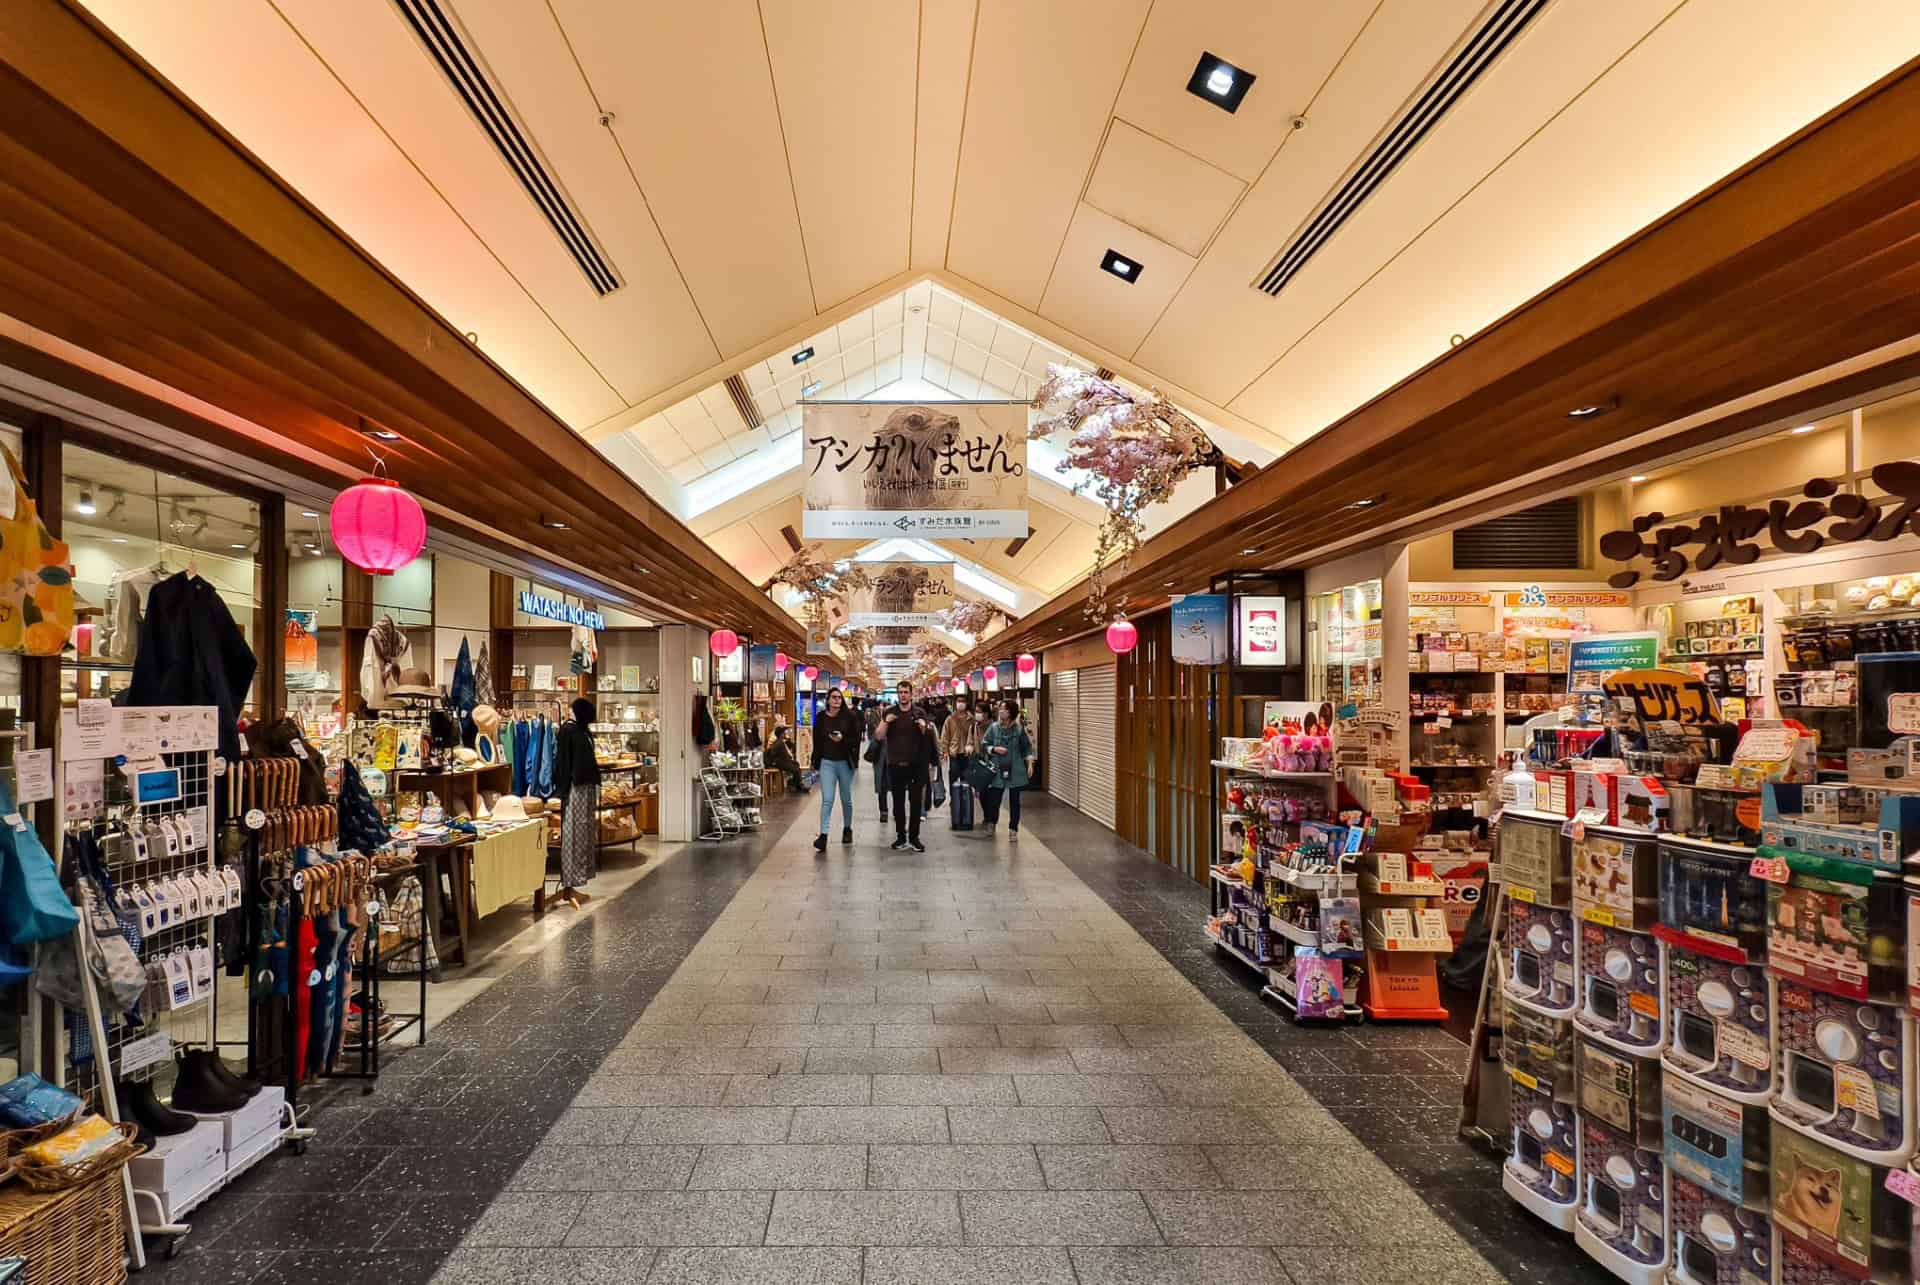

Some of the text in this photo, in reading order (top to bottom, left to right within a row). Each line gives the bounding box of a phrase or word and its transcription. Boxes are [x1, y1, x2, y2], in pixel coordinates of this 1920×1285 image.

[808, 432, 1024, 477] アシカ？いません。
[919, 516, 971, 526] すみだ水族館
[521, 591, 567, 621] WATASHI
[568, 606, 584, 625] NO
